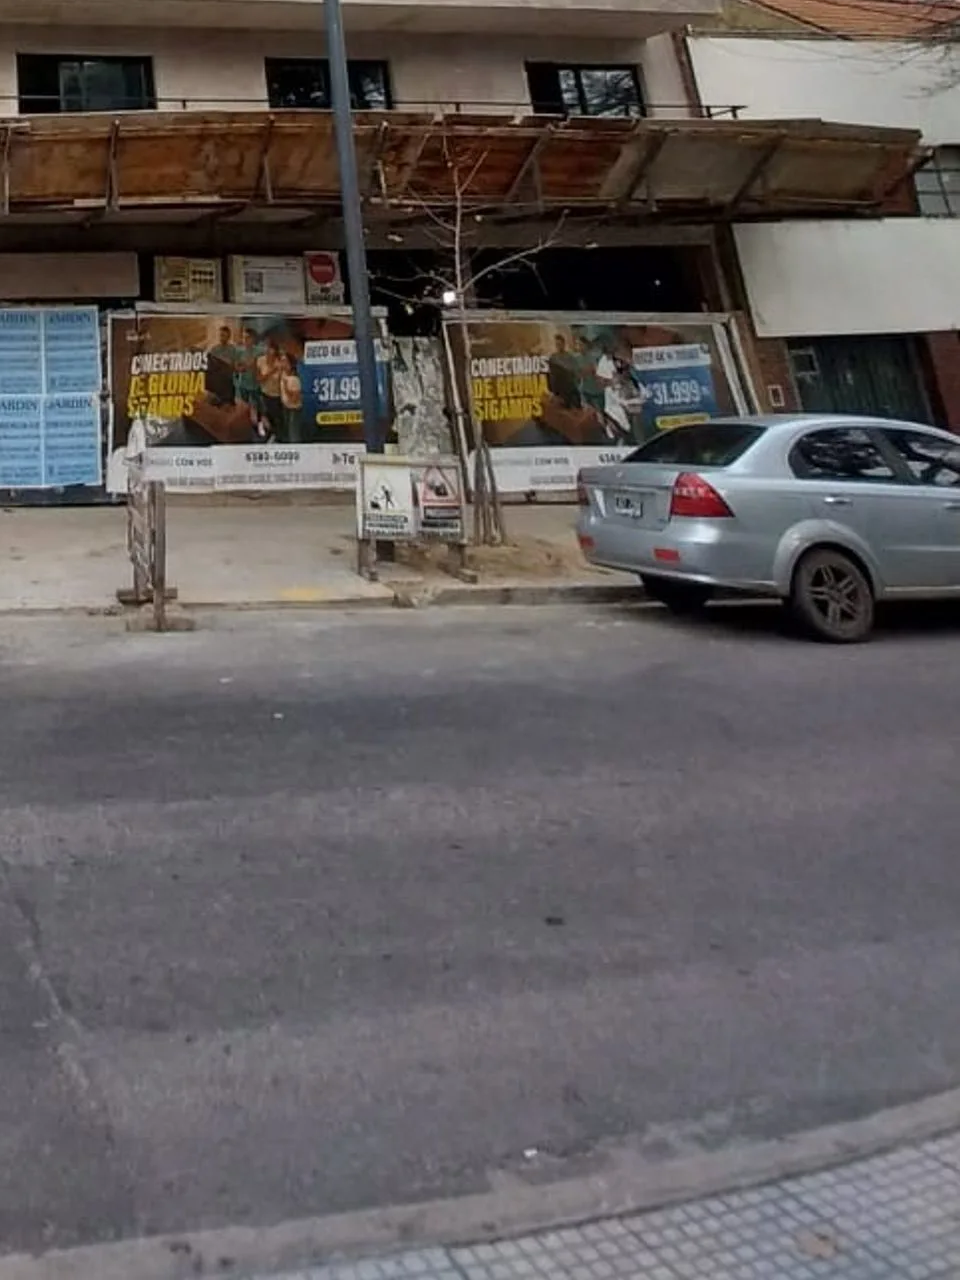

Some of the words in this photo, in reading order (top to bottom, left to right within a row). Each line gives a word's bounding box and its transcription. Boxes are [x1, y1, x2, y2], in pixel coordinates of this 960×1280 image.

[471, 355, 550, 377] CONECTADOS
[148, 371, 206, 395] GLORIA
[312, 375, 361, 402] $31.99
[474, 377, 495, 399] DE
[496, 374, 549, 397] GLORIA
[473, 397, 544, 421] SIGAMOS
